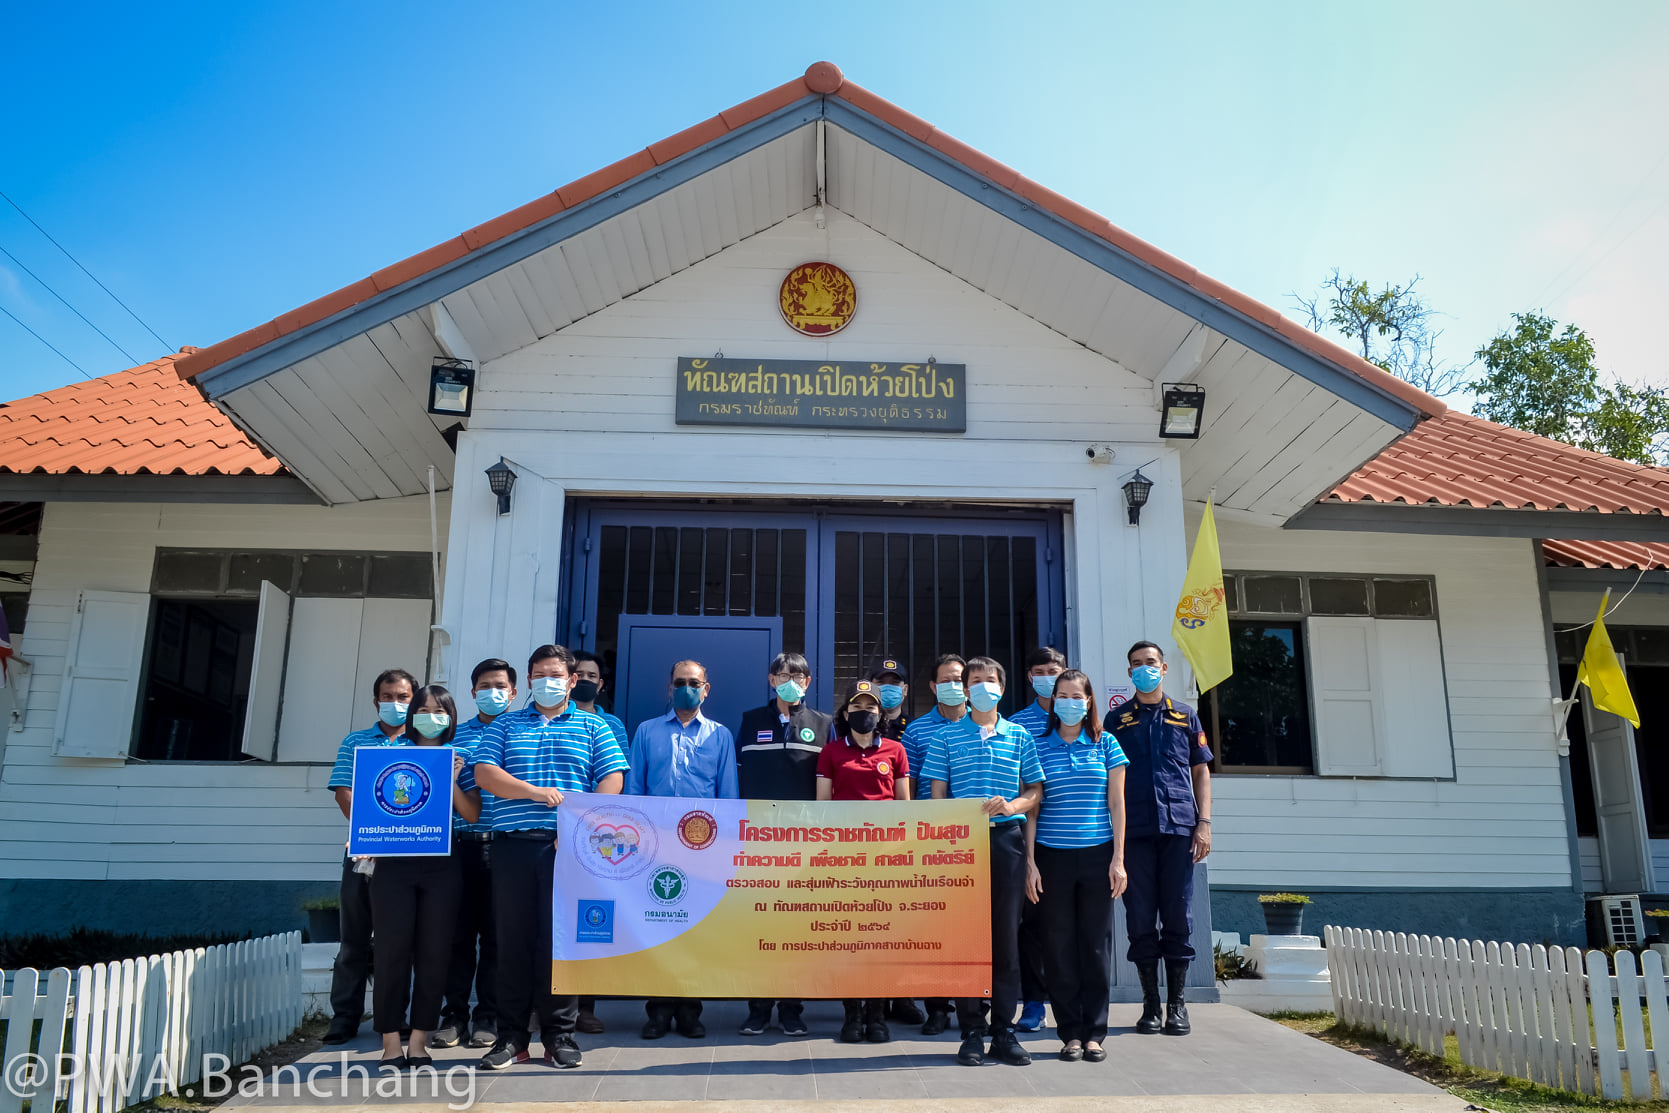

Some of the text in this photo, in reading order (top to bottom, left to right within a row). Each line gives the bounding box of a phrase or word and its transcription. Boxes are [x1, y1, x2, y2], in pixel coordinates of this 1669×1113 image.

[684, 358, 954, 399] ทัณฑสถานเปิดห้วยโป่ง
[699, 398, 947, 424] กรมราชทัณฑ์ กระทรวงยุติธรรม
[358, 824, 442, 835] การประปาส่วนภูมิภาค
[738, 819, 906, 842] โครงการราชทัณฑ์
[917, 821, 970, 845] ปันสุข
[733, 848, 975, 867] ทำความดี เพื่อชาติ ศาสน์ กษัตริย์
[726, 874, 975, 892] ตรวจสอบ และสุ่มเฝ้าระวังคุณภาพน้ำในเรือนจำ
[645, 909, 689, 918] กรมอนามัย
[754, 902, 767, 912] ณ
[899, 901, 946, 912] จ.ระยอง
[810, 919, 890, 932] ประจำปี ๒๕๖๔
[759, 938, 942, 953] โดย การประปาส่วนภูมิภาคสาขาบ้านฉาง
